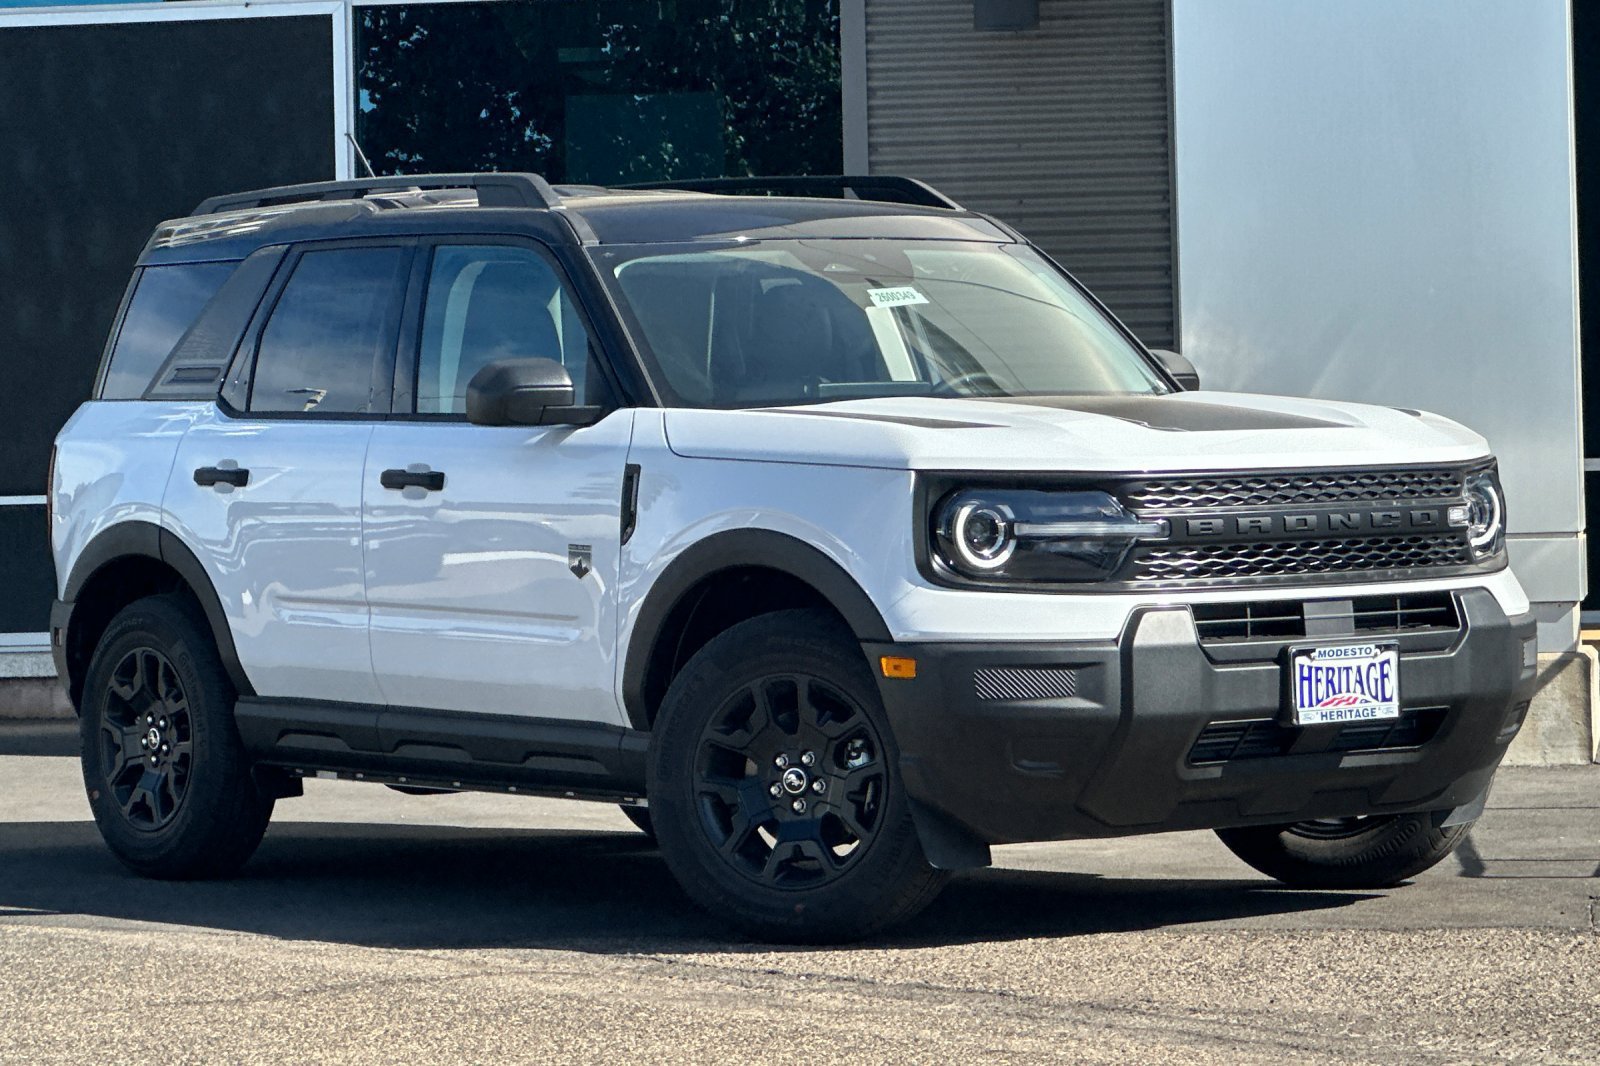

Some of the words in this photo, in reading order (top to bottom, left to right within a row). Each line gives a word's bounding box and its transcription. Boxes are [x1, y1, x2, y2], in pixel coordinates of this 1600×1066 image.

[1186, 509, 1439, 536] BRONCO
[1317, 646, 1372, 658] MODESTO
[1298, 658, 1395, 708] HERITAGE
[1320, 707, 1377, 721] HERITAGE
